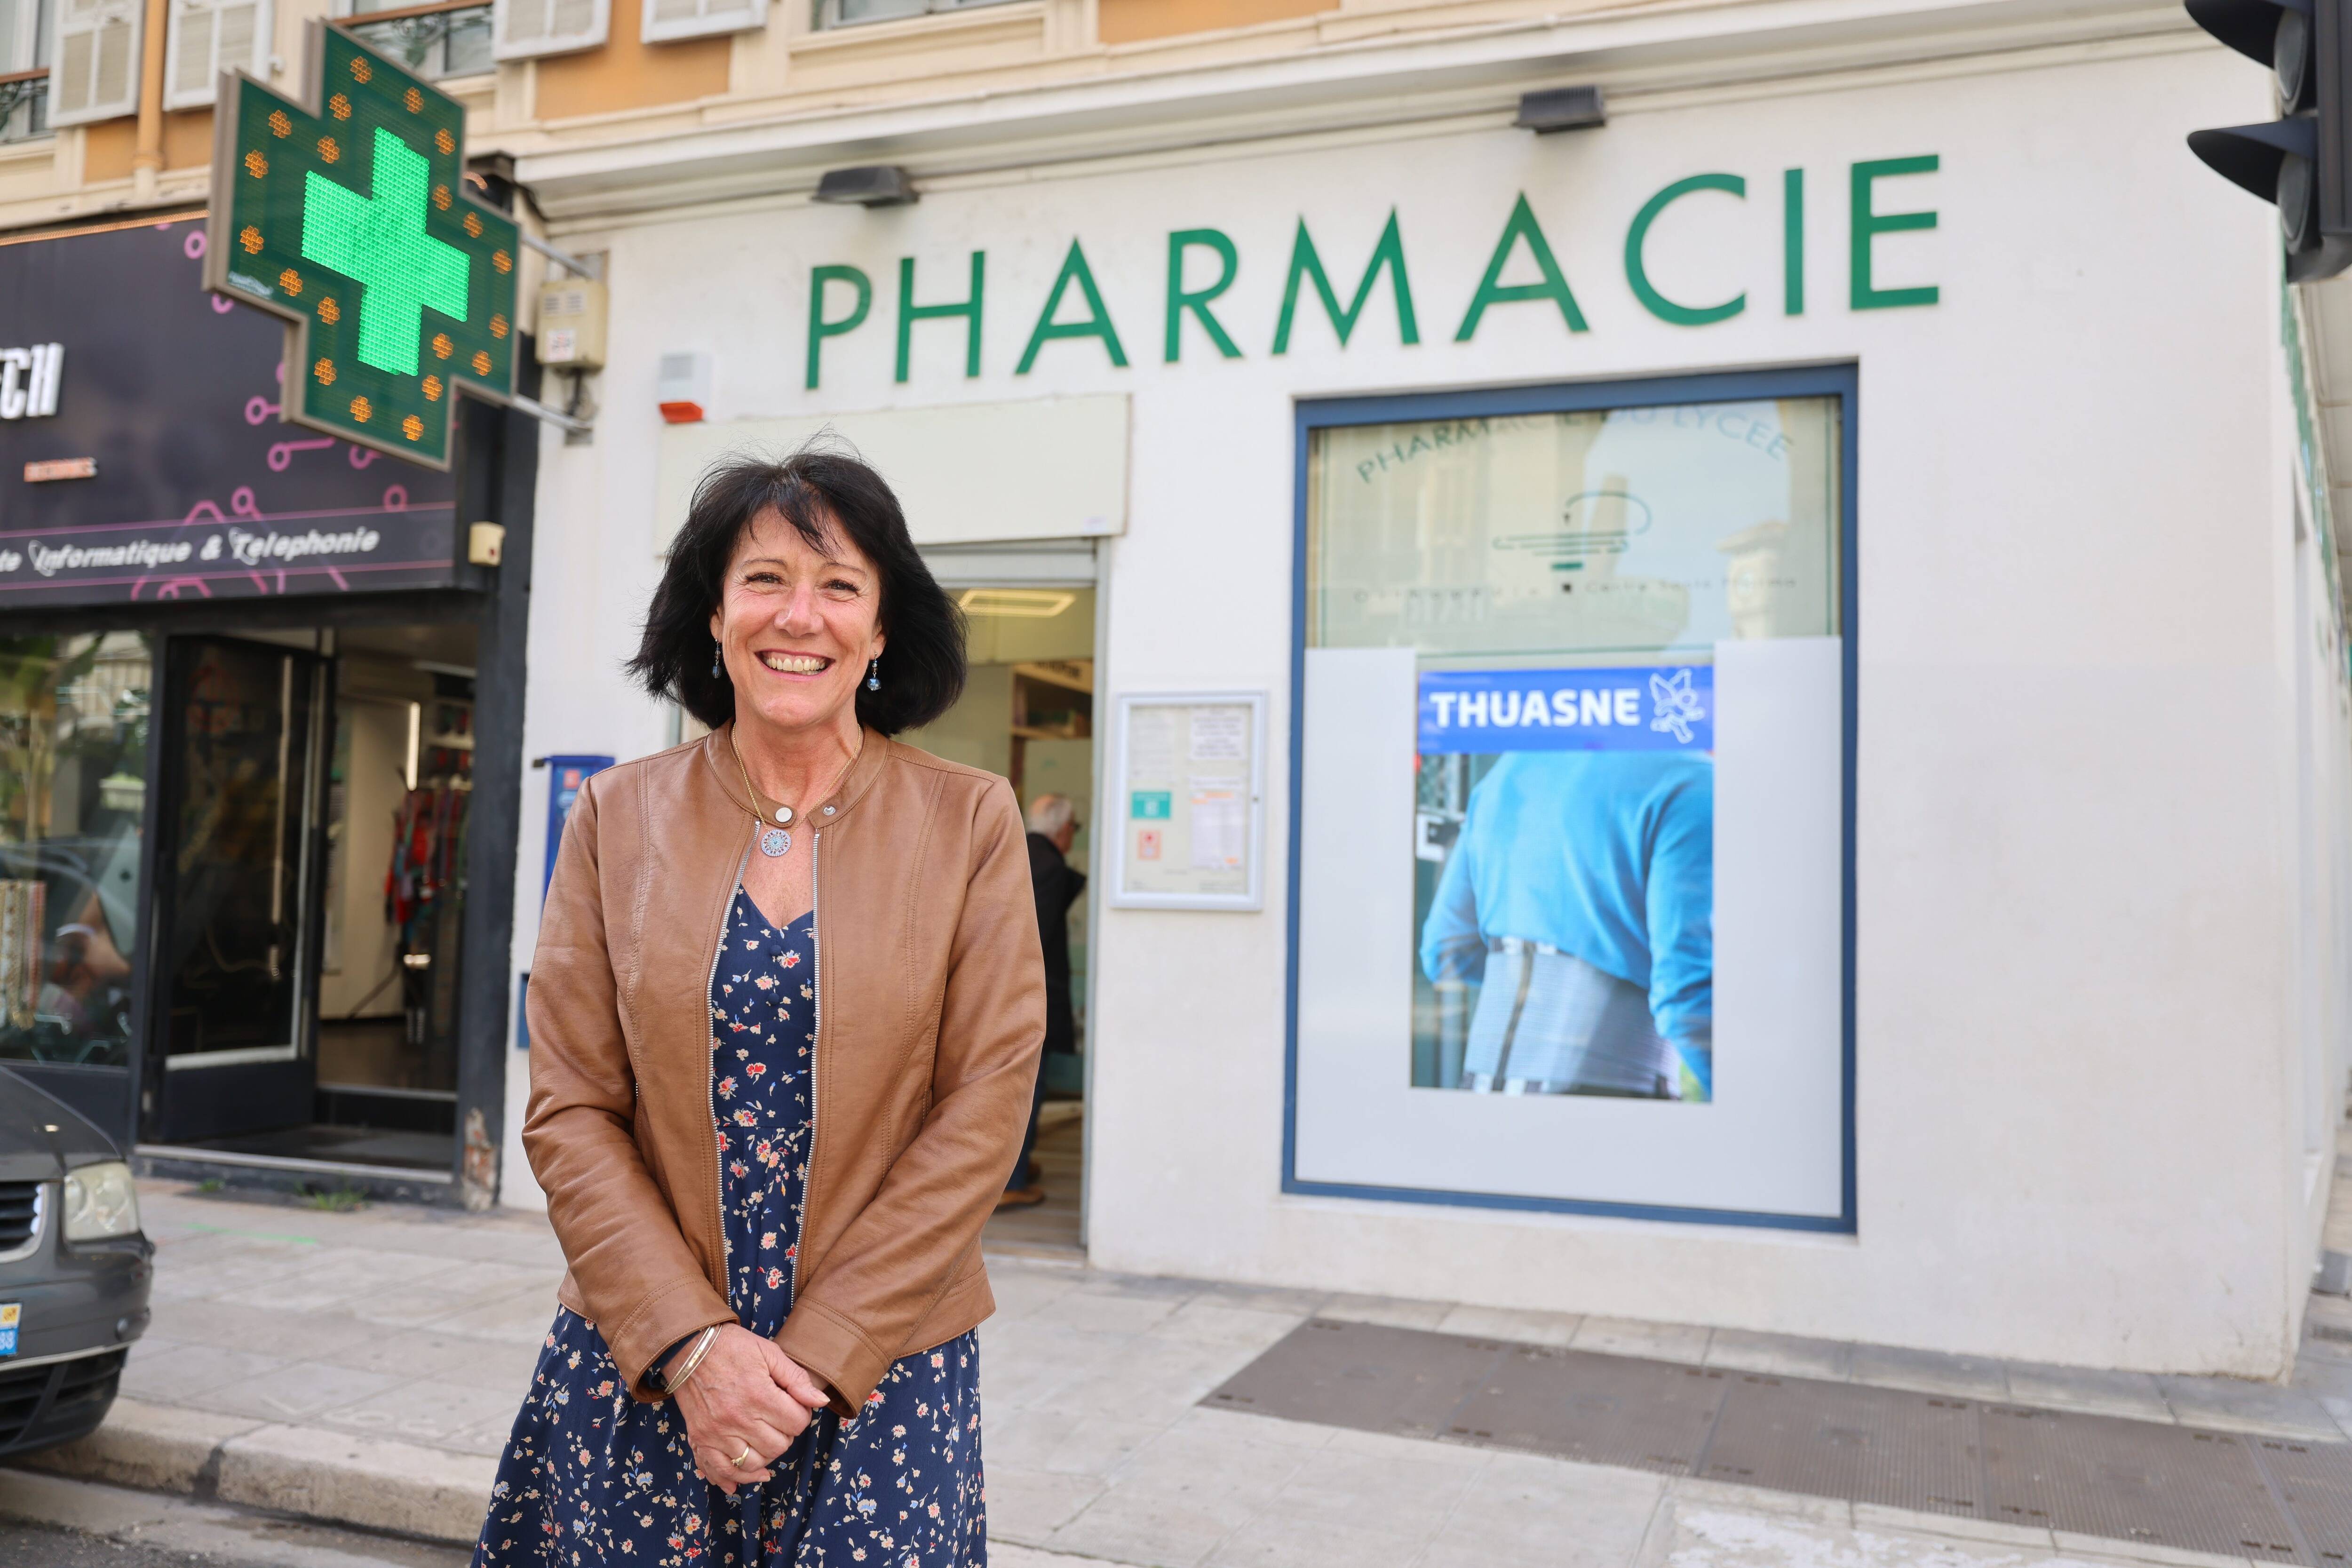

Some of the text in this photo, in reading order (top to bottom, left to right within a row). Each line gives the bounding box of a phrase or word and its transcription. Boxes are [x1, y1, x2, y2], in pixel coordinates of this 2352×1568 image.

[806, 155, 1939, 389] PHARMACIE
[0, 342, 64, 420] CH
[28, 539, 192, 577] Informatique
[200, 533, 223, 561] &
[1429, 688, 1641, 728] THUASNE
